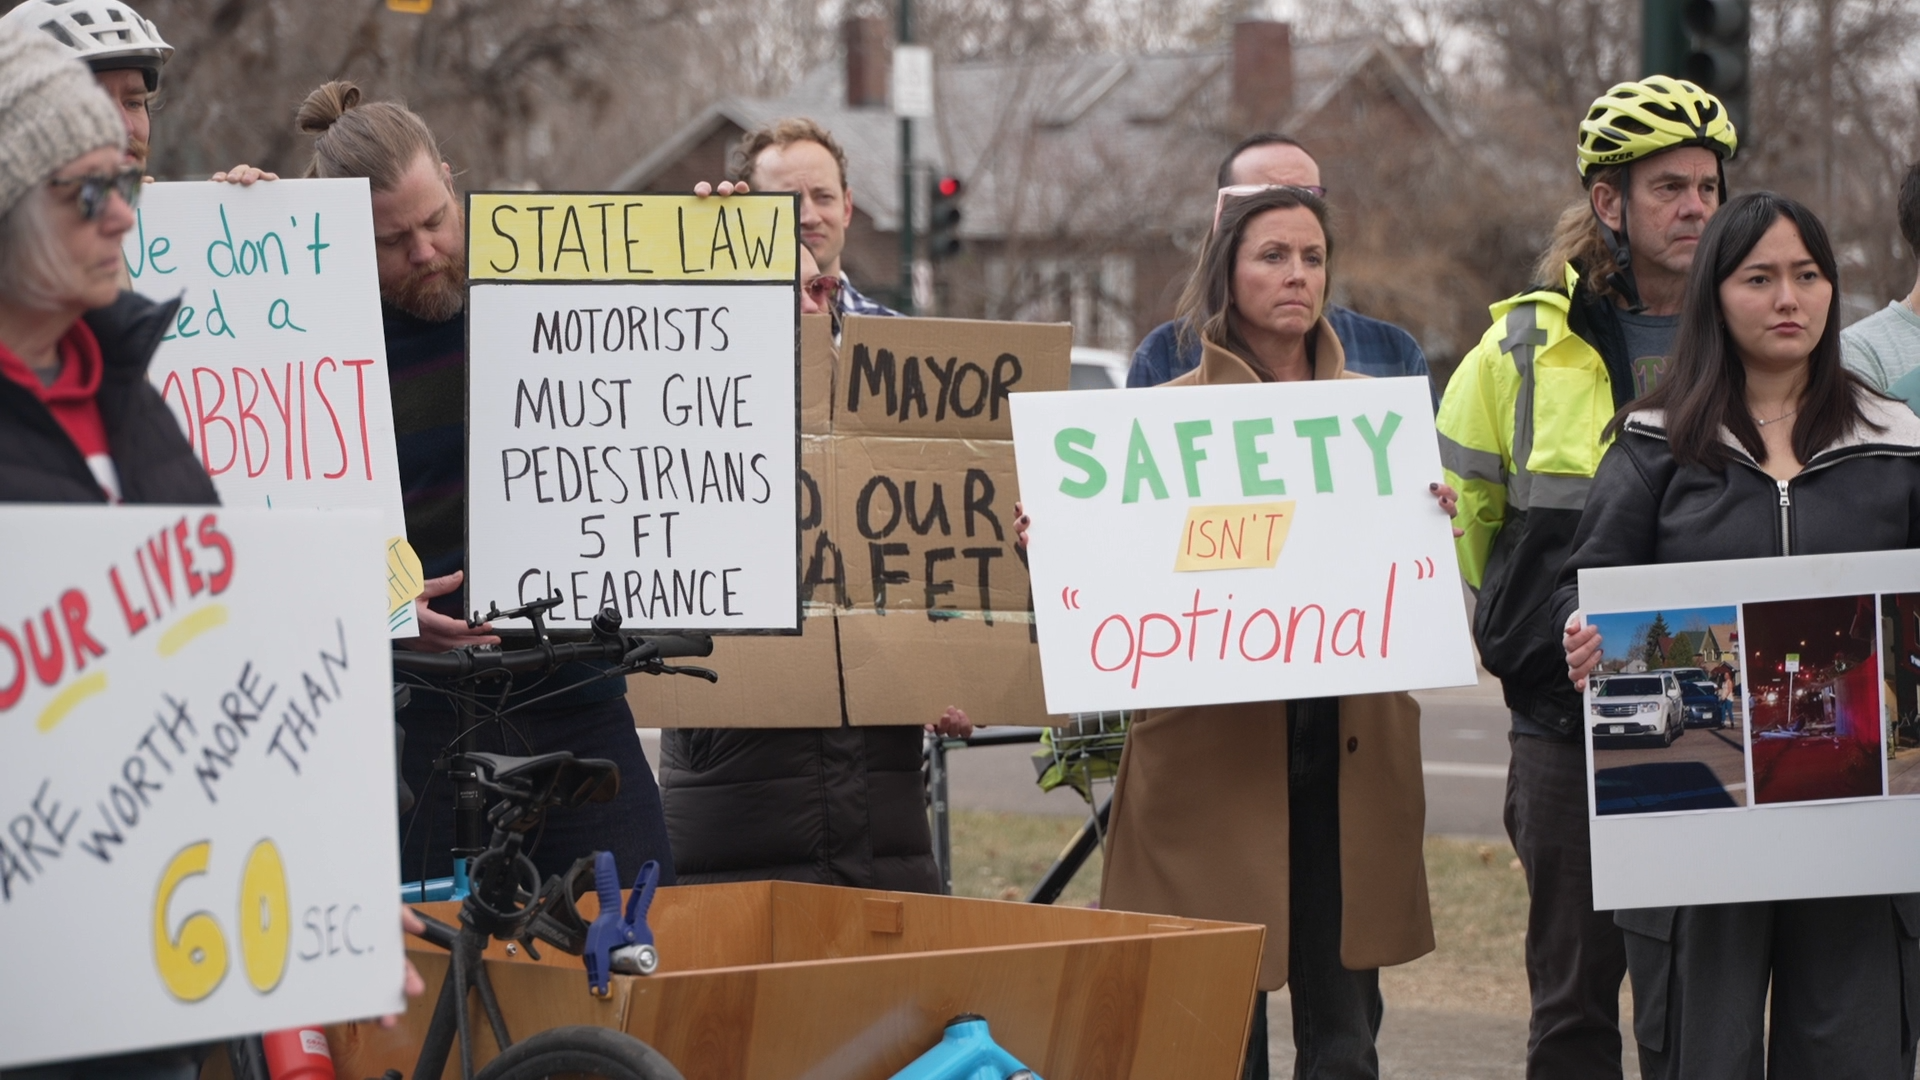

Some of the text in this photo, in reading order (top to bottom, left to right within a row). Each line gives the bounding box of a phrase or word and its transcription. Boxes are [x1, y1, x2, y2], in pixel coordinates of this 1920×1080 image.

[1598, 151, 1634, 163] LAZER
[207, 203, 330, 278] don't
[489, 203, 779, 274] STATE LAW
[160, 289, 307, 341] ed a
[532, 305, 730, 354] MOTORISTS
[162, 356, 375, 481] OBBYIST
[514, 373, 753, 430] MUST GIVE
[847, 342, 1023, 423] MAYOR
[501, 445, 771, 504] PEDESTRIANS
[1054, 410, 1403, 504] SAFETY
[579, 511, 680, 559] 5 FT
[855, 468, 1005, 541] OUR
[1186, 513, 1284, 562] ISN'T
[0, 512, 236, 712] OUR LIVES
[517, 567, 744, 621] CLEARANCE
[802, 528, 1038, 644] AFET
[0, 618, 349, 901] ARE WORTH MORE THAN
[152, 838, 375, 1003] 60 SEC.
